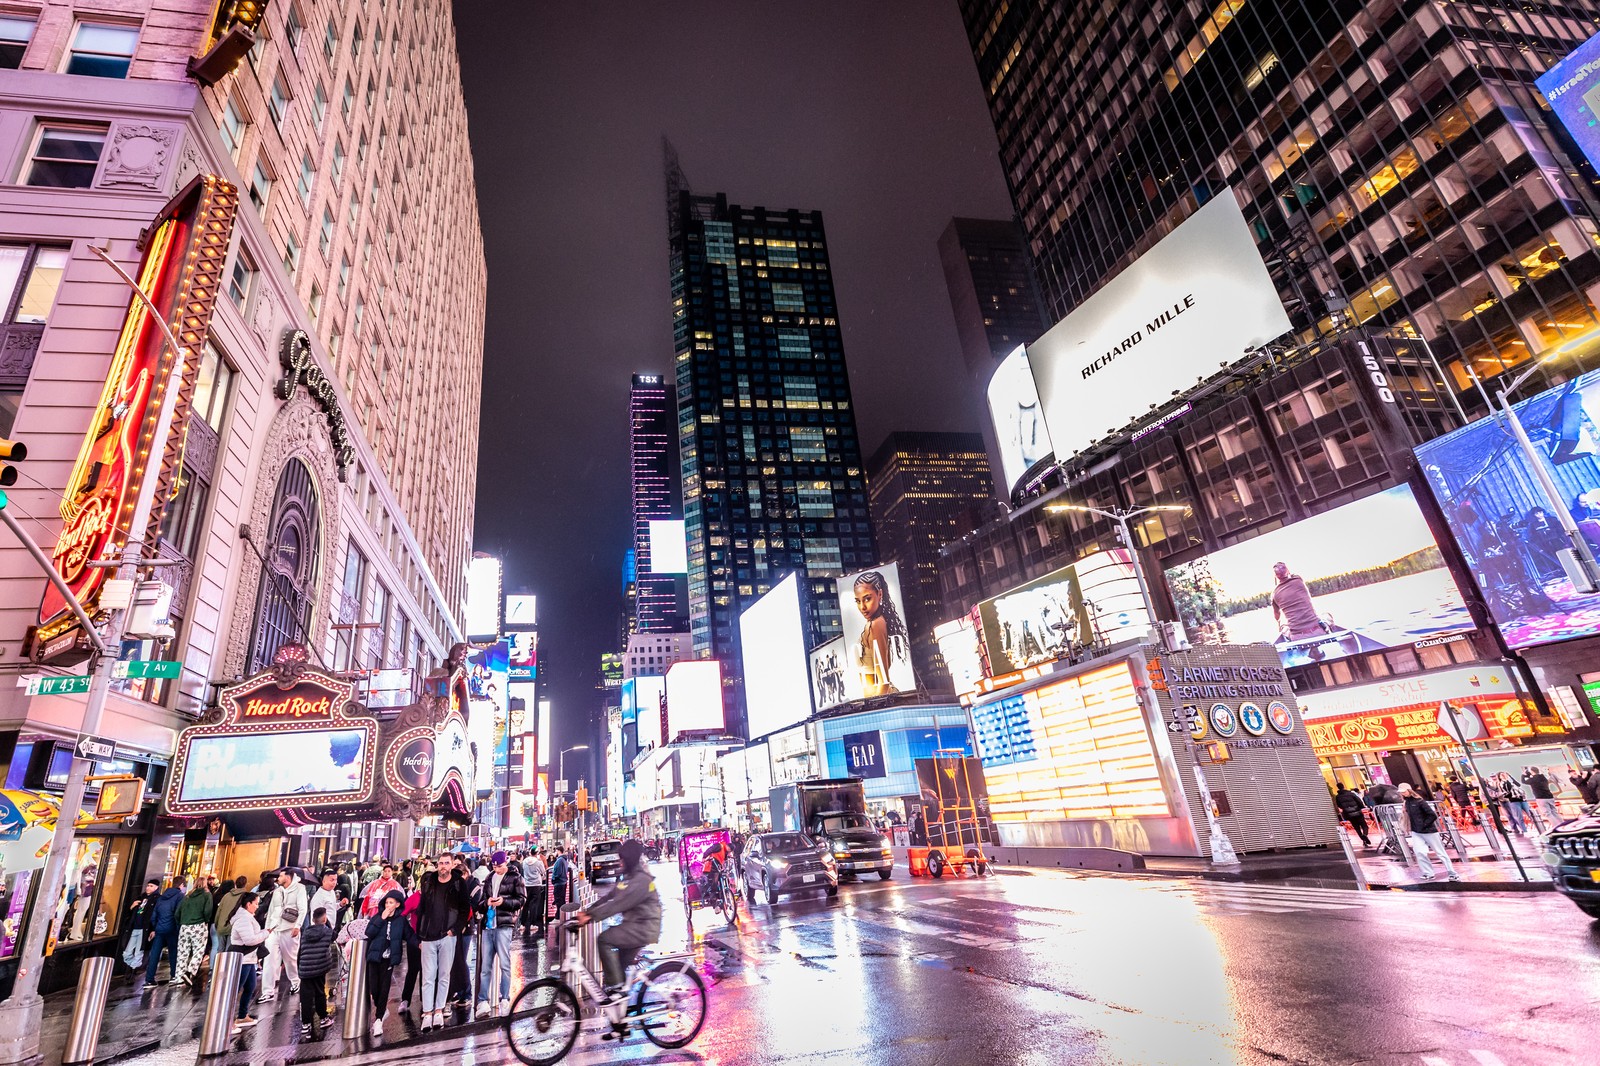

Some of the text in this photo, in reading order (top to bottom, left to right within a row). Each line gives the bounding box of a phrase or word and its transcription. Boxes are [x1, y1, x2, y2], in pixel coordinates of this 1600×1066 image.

[1081, 293, 1196, 380] RICHARD MILLE
[639, 375, 658, 384] TSX
[1357, 341, 1396, 403] 1500
[52, 501, 112, 560] Hard Rock
[142, 662, 168, 676] 7 Av
[1183, 666, 1231, 683] ARMED
[1232, 664, 1284, 682] FORCES
[42, 677, 90, 693] W 43 St
[1168, 683, 1284, 699] ECRUITING STATION
[1379, 680, 1429, 698] STYLE
[245, 696, 332, 718] Hard Rock
[1396, 722, 1440, 738] SHOP
[81, 739, 111, 756] ONE WAY
[1250, 738, 1272, 748] FORCE
[1314, 742, 1372, 754] TIMES SQUARE
[402, 756, 422, 767] Hard
[851, 743, 876, 768] GAP
